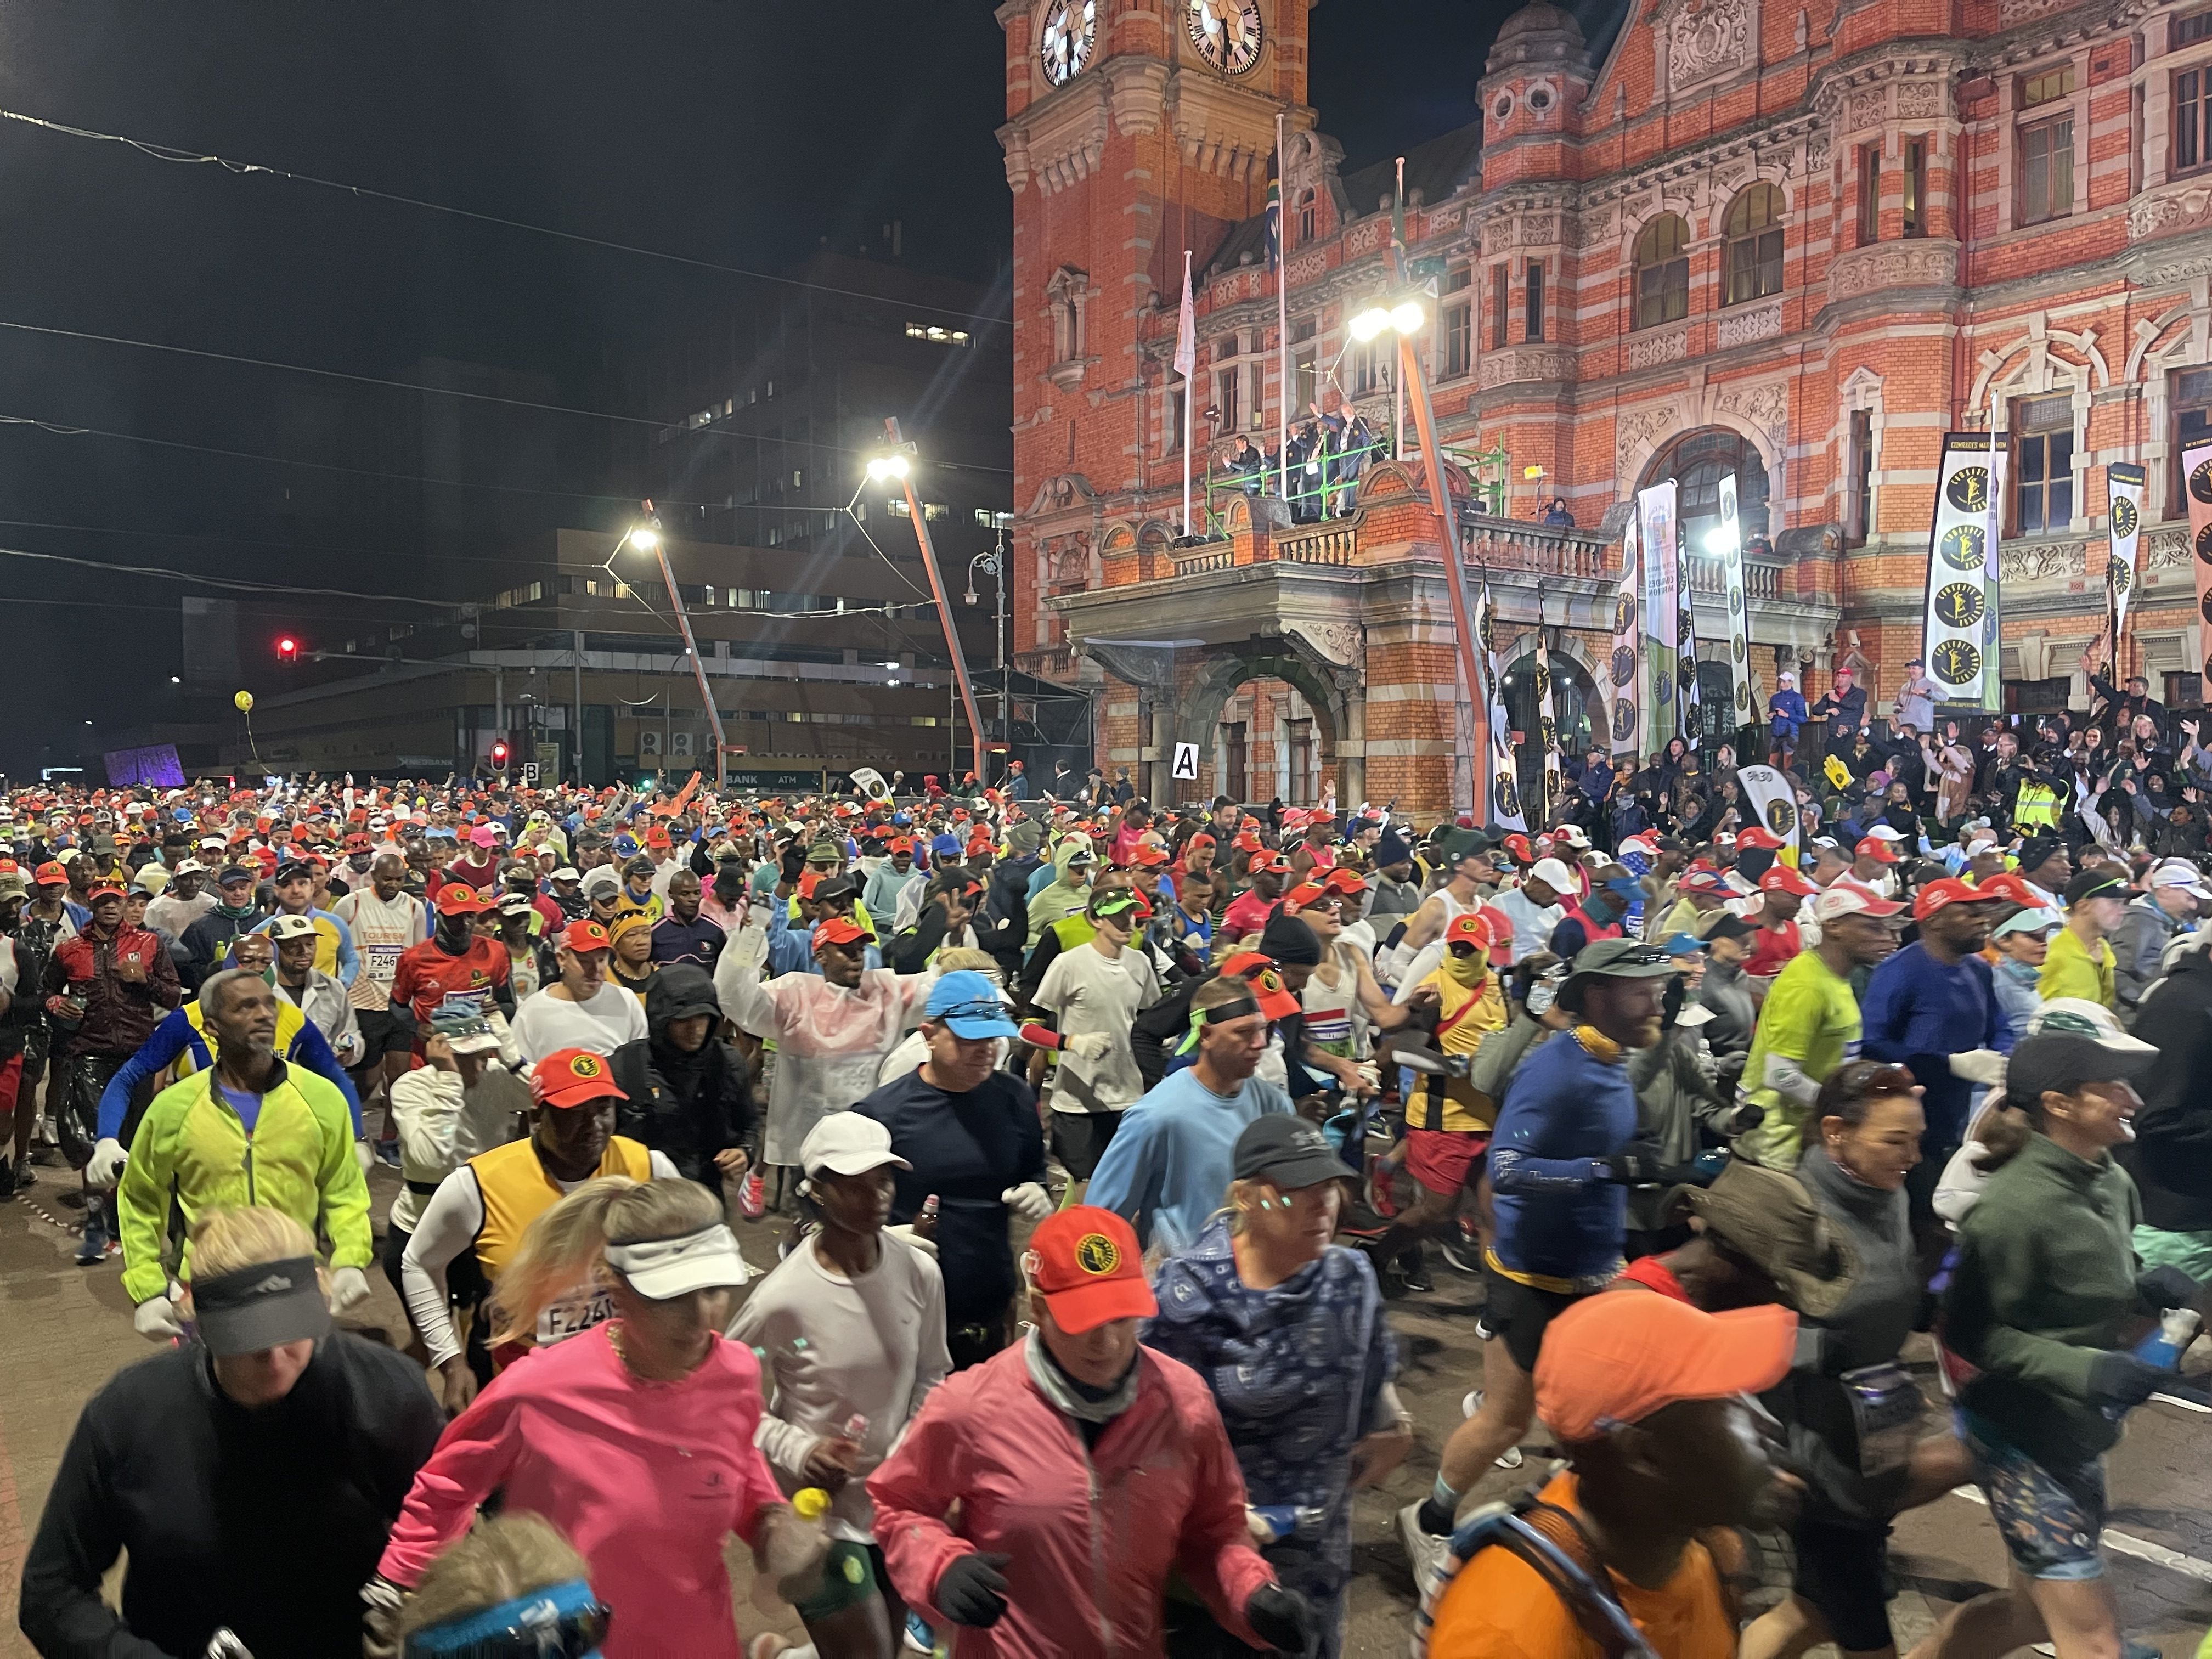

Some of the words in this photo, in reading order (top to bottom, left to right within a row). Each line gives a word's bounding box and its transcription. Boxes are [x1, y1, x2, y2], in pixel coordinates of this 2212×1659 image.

[1175, 746, 1194, 776] A
[527, 764, 536, 779] B
[727, 775, 758, 784] BANK
